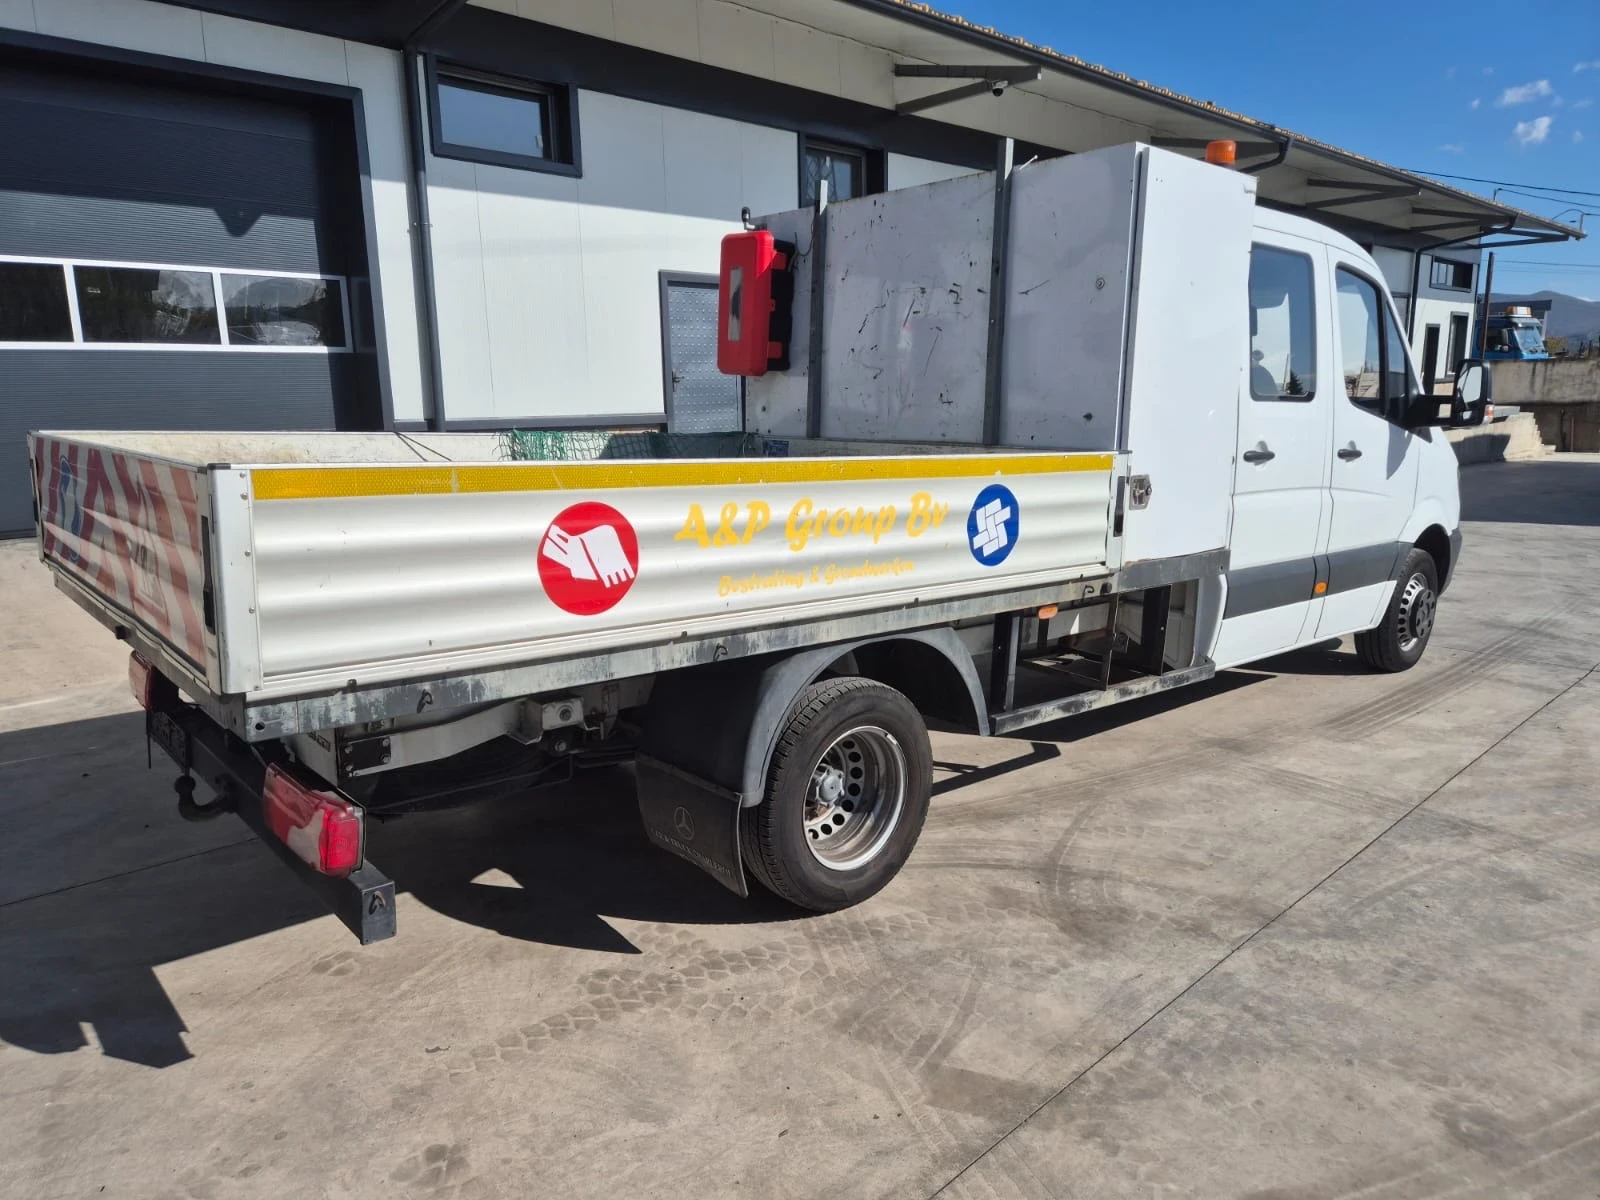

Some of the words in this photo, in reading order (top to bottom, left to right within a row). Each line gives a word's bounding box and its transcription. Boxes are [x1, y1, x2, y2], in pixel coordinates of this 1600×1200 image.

[674, 500, 771, 549] A&P
[784, 497, 897, 552] Group
[906, 491, 949, 537] Bv
[718, 571, 806, 597] Bestrating
[809, 565, 820, 583] &
